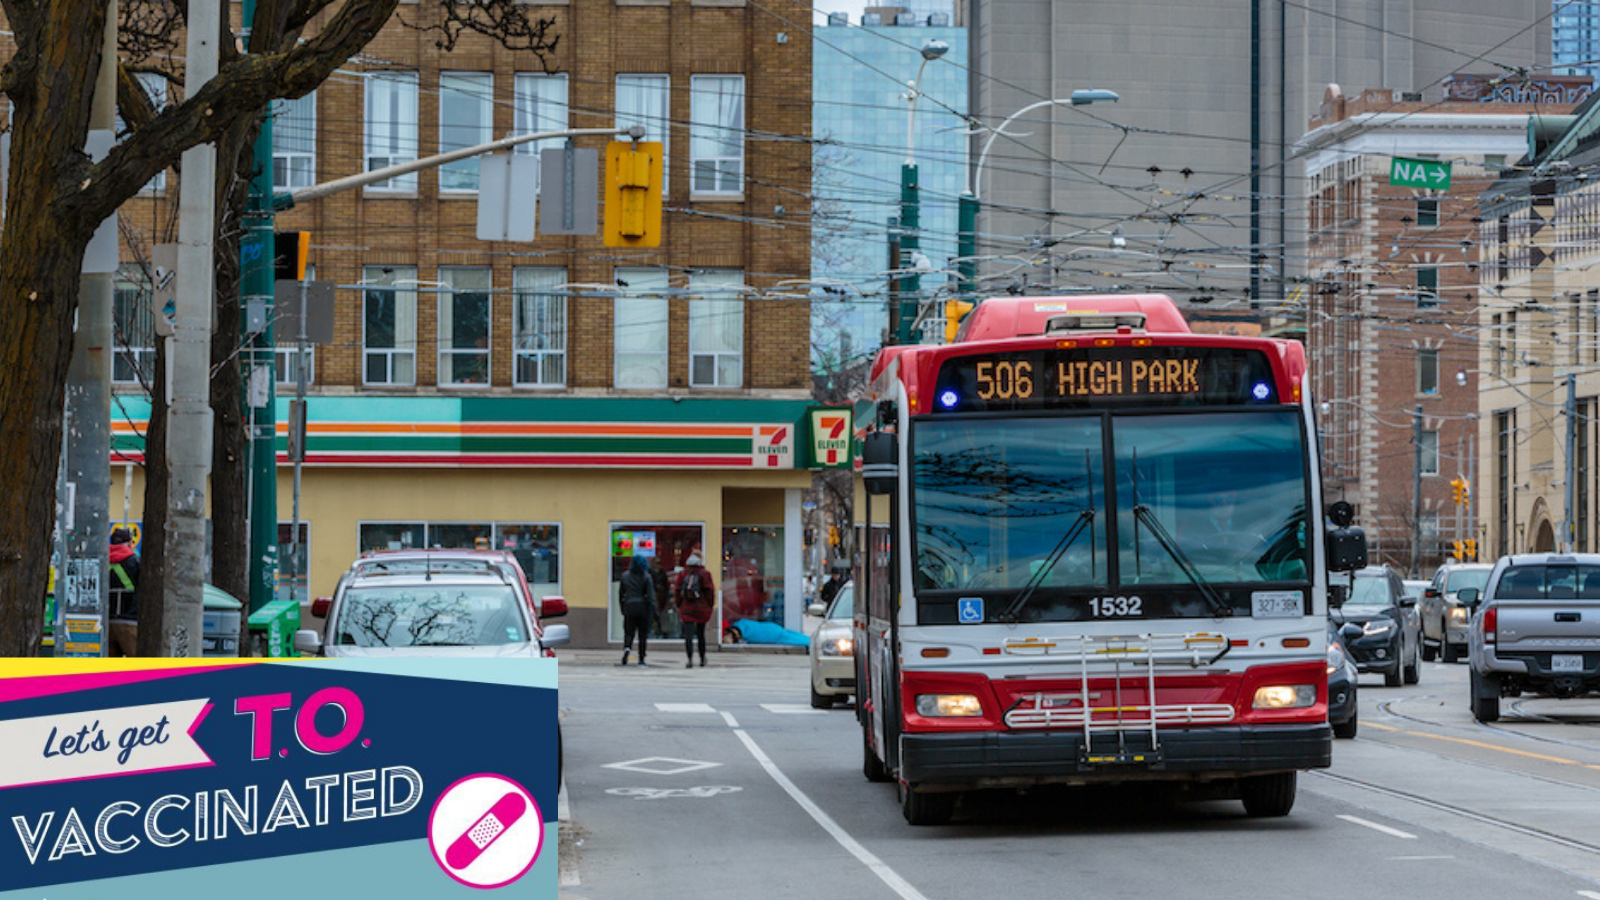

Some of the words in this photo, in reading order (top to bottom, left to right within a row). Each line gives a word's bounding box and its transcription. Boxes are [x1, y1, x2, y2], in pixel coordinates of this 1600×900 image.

[1394, 162, 1427, 181] NA
[977, 361, 1033, 398] 506
[1058, 361, 1123, 395] HIGH
[1131, 359, 1199, 393] PARK
[1089, 596, 1142, 617] 1532
